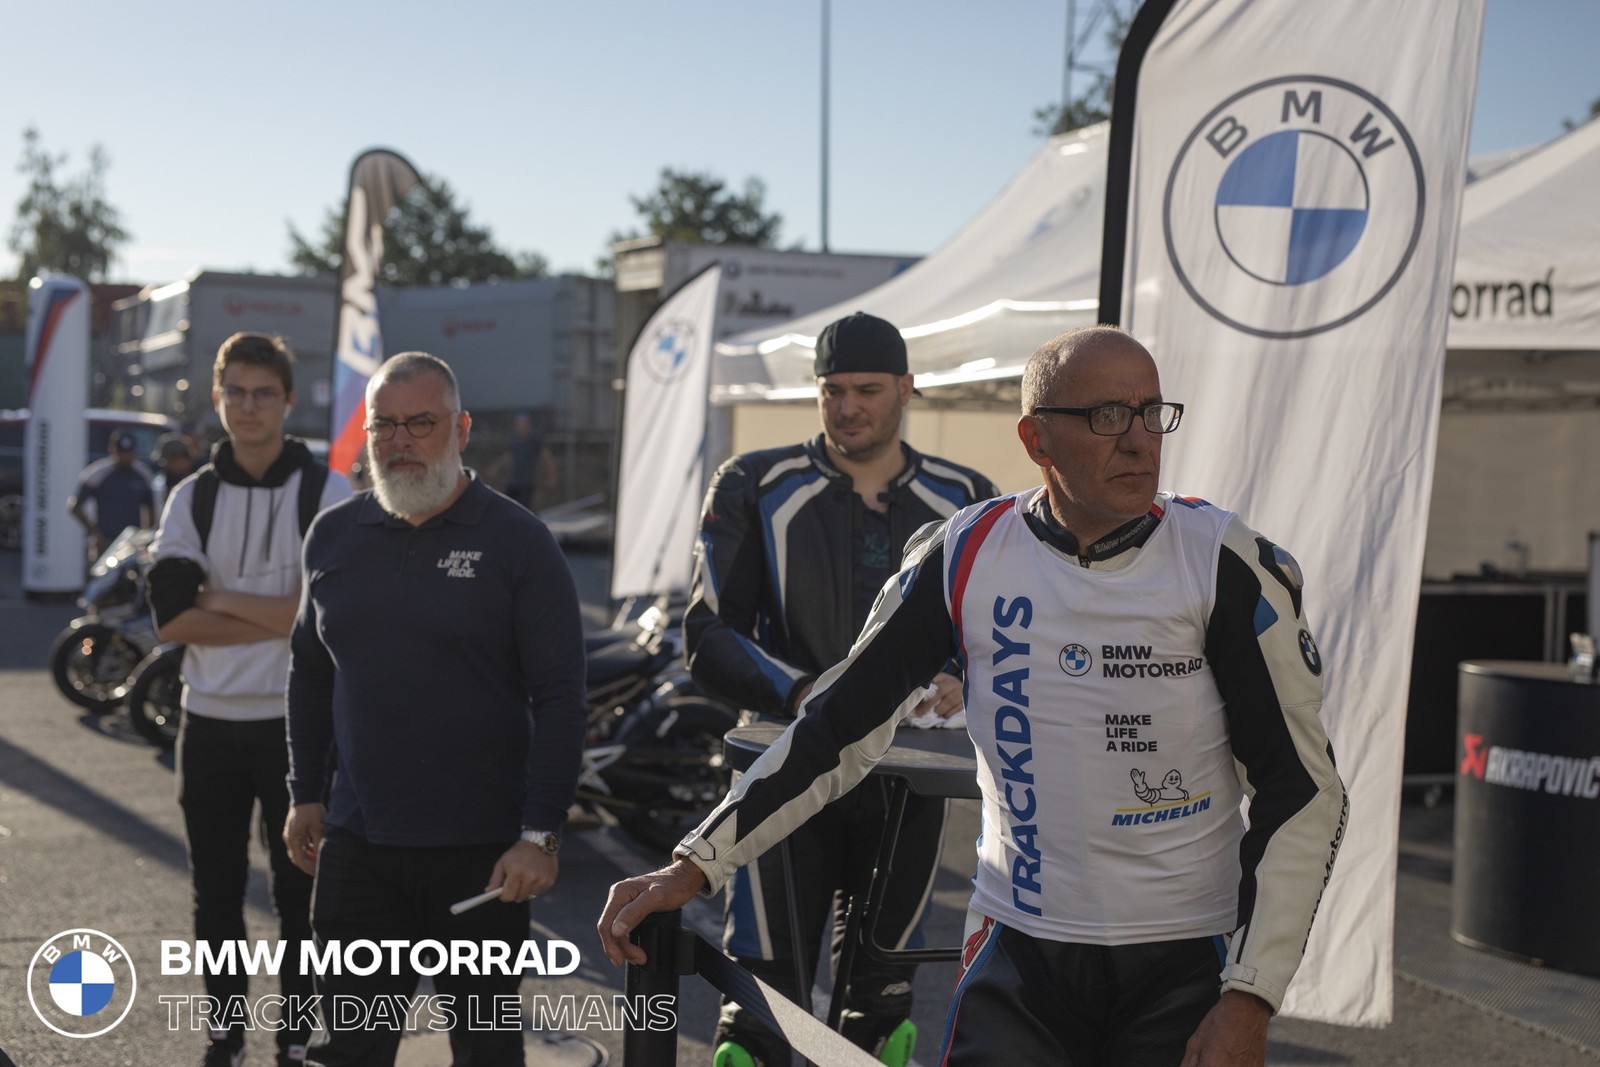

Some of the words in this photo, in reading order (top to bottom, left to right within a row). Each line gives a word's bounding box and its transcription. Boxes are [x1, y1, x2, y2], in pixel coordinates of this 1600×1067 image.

[1206, 90, 1395, 159] BMW
[1450, 267, 1555, 320] orrad
[449, 550, 483, 561] MAKE
[437, 558, 462, 569] LIFE
[461, 560, 471, 569] A
[1063, 645, 1088, 655] BMW
[1102, 645, 1152, 660] BMW
[1102, 657, 1204, 679] MOTORRAD
[1105, 714, 1152, 726] MAKE
[1106, 727, 1138, 739] LIFE
[1106, 741, 1118, 752] A
[1121, 741, 1158, 752] RIDE
[992, 595, 1042, 917] TRACKDAYS
[1111, 797, 1211, 827] MICHELIN
[1323, 775, 1347, 889] Motorra
